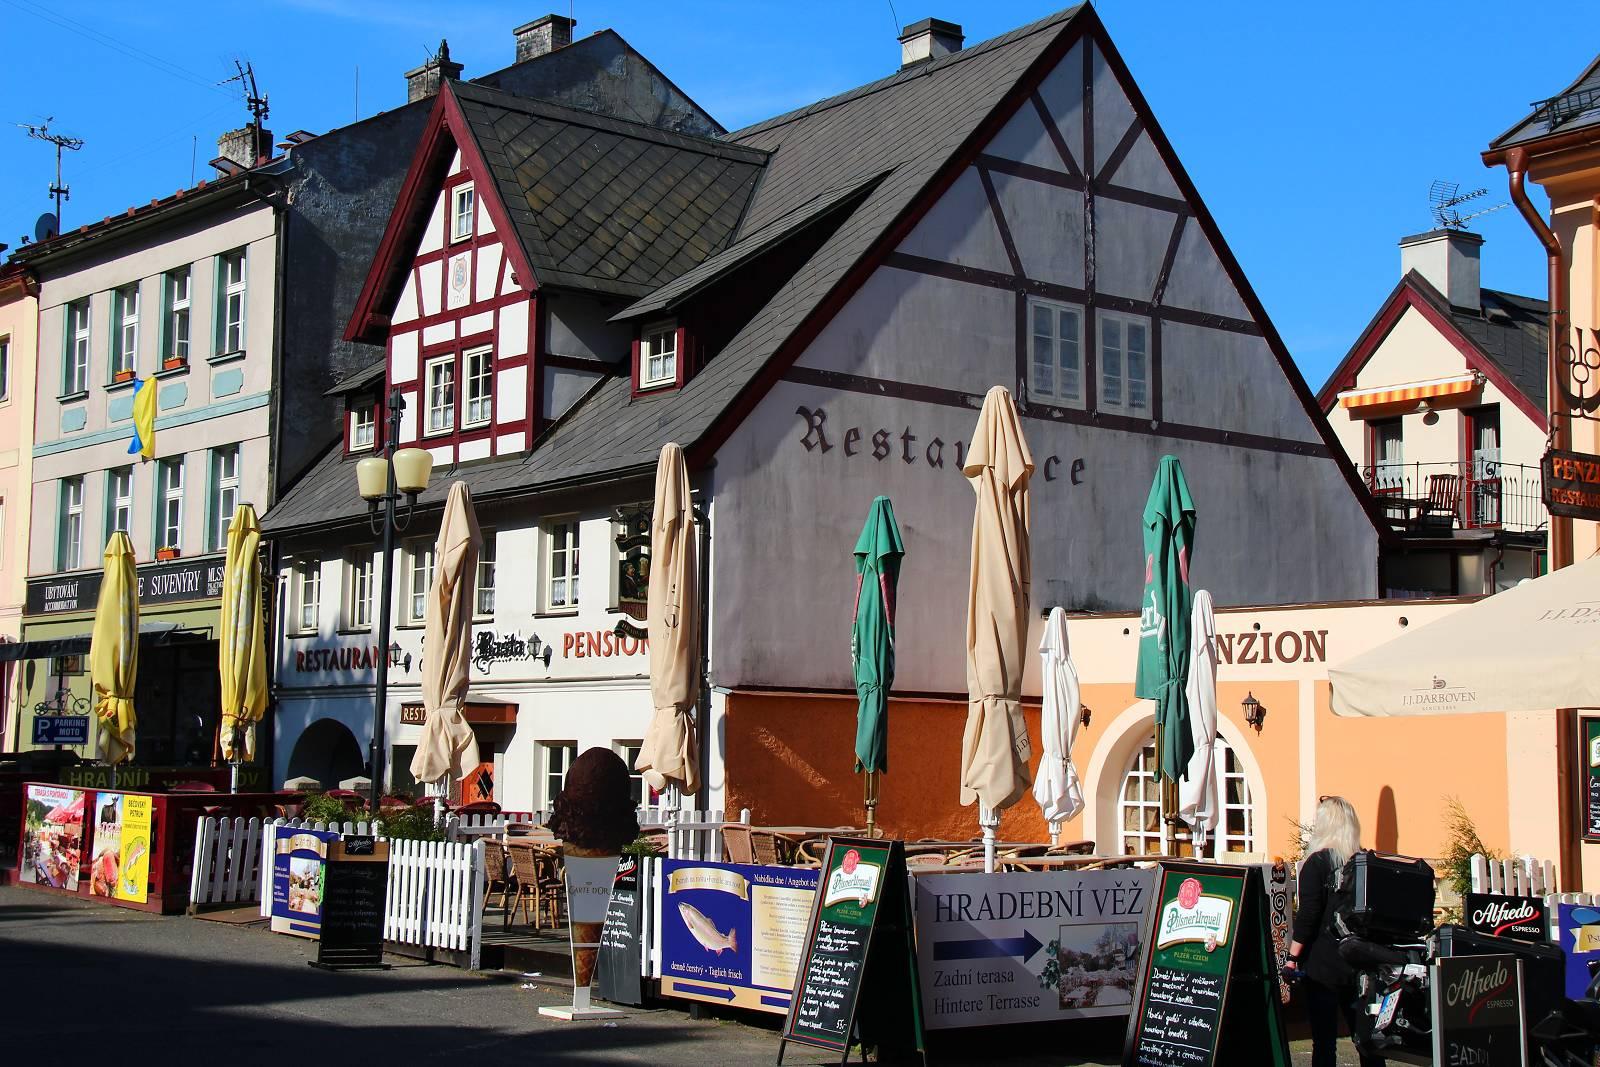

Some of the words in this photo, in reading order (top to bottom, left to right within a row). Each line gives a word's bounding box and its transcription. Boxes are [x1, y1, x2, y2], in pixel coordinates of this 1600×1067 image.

[796, 405, 1086, 486] Restauce
[1552, 456, 1600, 484] PENZI
[45, 580, 78, 599] UBYTOVÁNÍ
[151, 568, 201, 596] SUVENÝRY
[1216, 629, 1329, 665] NZION
[38, 719, 50, 736] P
[54, 718, 86, 728] PARKING
[59, 727, 80, 736] MOTO
[753, 873, 775, 884] Nabídka
[775, 875, 785, 885] dne
[788, 877, 809, 888] Angebot
[831, 872, 854, 895] Pilsner
[853, 874, 873, 891] Urquell
[934, 881, 1085, 923] HRADEBNÍ
[1091, 879, 1144, 915] VĚŽ
[1166, 907, 1196, 934] Pilsner
[1195, 908, 1222, 931] Urquell
[1472, 900, 1534, 928] Alfredo
[1511, 925, 1540, 934] ESPRESSO
[670, 960, 686, 971] denně
[686, 963, 704, 976] čerstvý
[727, 968, 743, 980] frisch
[933, 968, 972, 987] Zadní
[976, 968, 1014, 984] terasa
[1447, 960, 1508, 1008] Alfredo
[934, 997, 983, 1015] Hintere
[986, 993, 1041, 1011] Terrasse
[1486, 999, 1514, 1009] ESPRESSO
